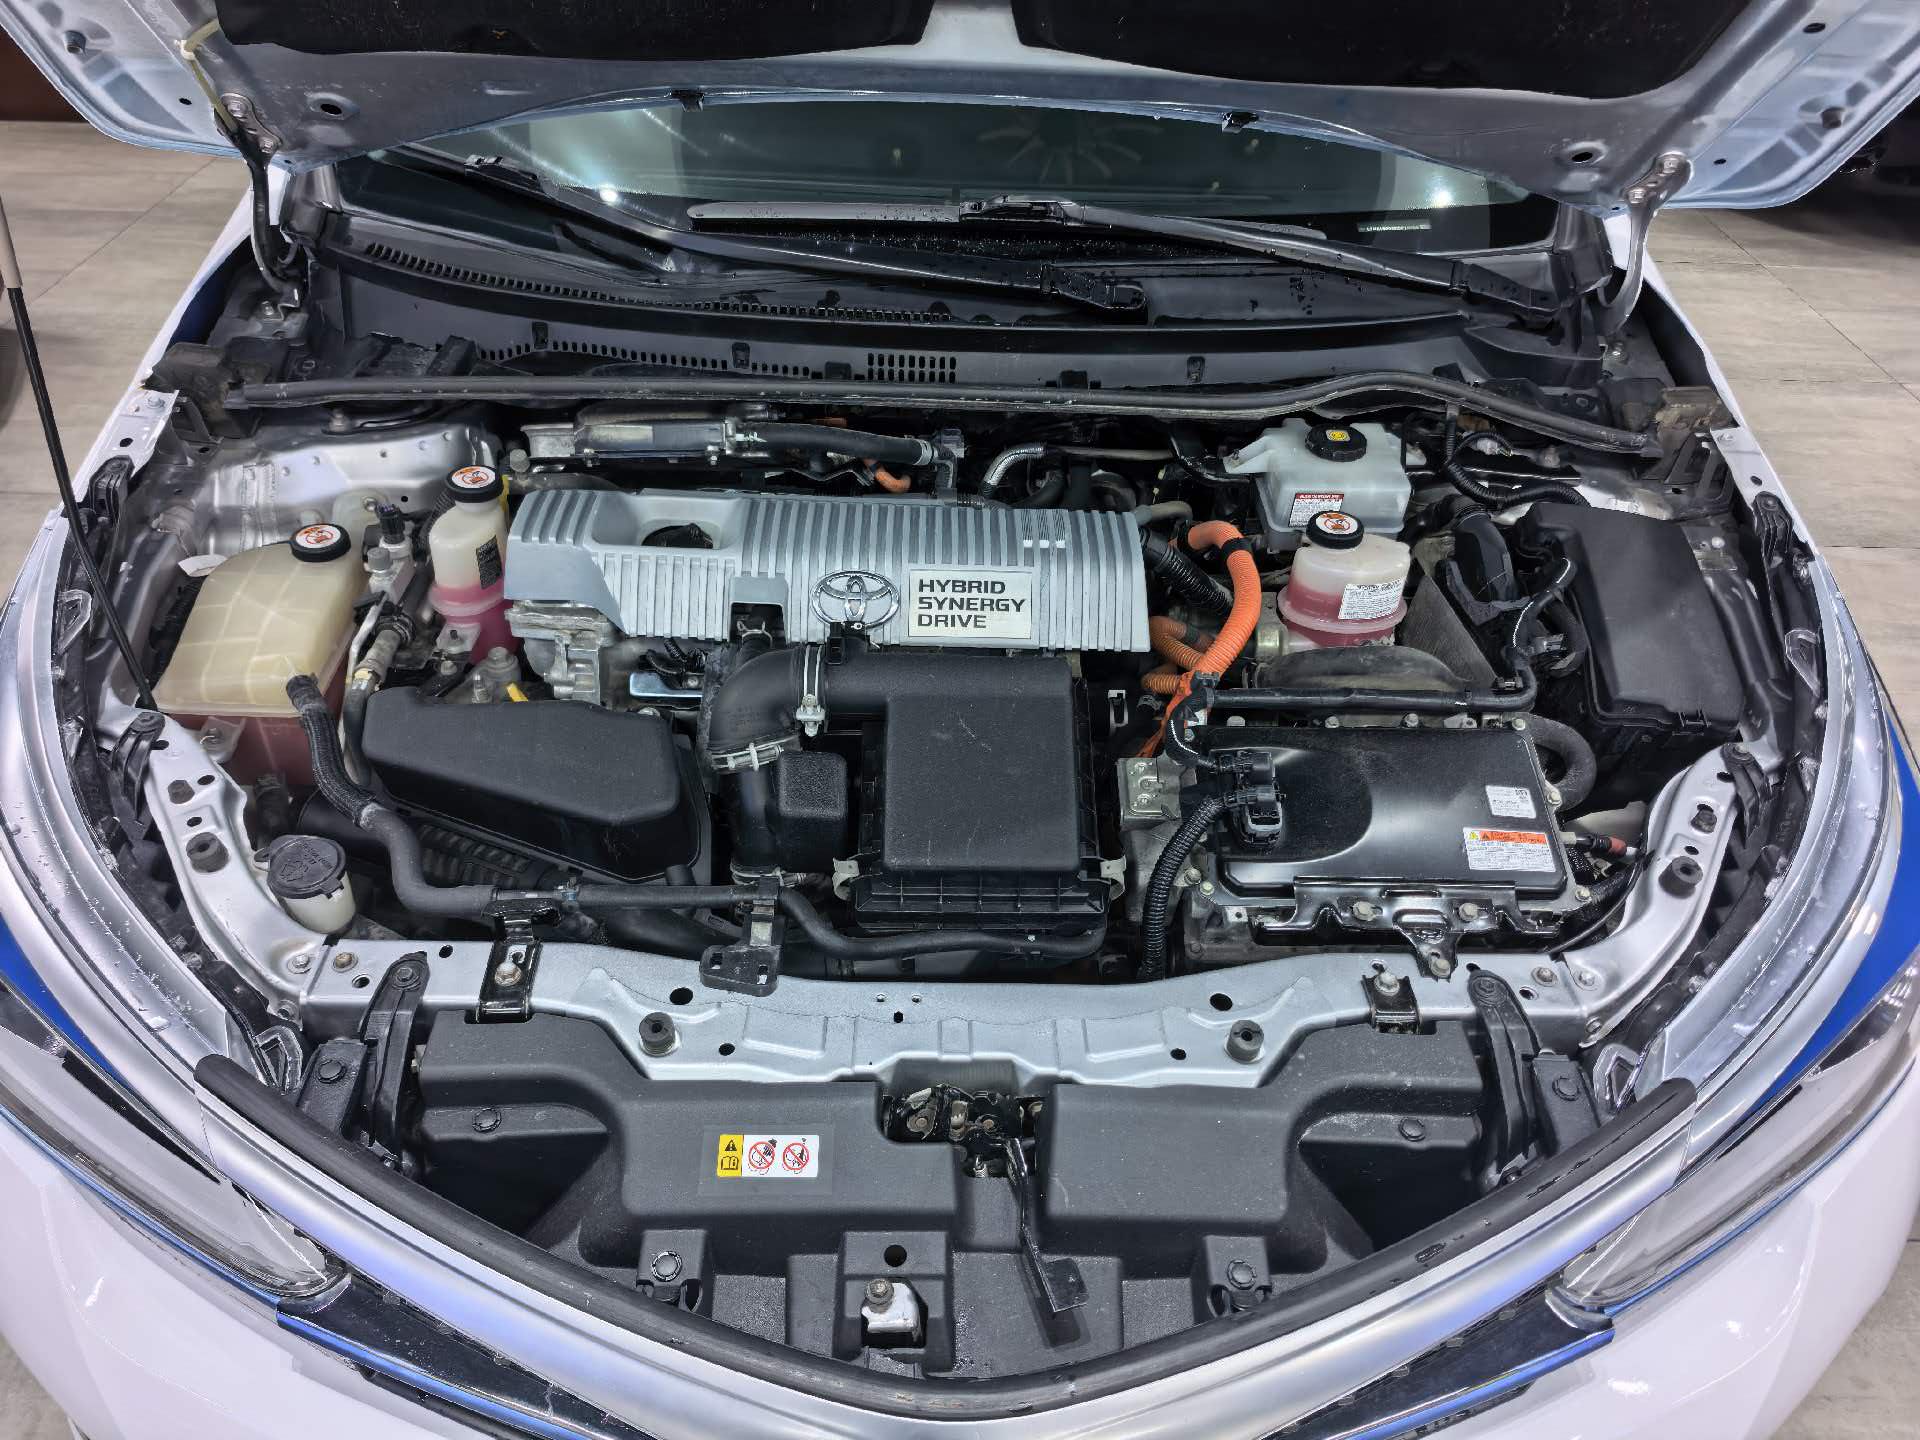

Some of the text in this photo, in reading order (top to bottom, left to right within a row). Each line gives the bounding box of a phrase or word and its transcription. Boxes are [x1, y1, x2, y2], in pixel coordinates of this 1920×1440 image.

[918, 579, 1006, 594] HYBRID
[918, 596, 1026, 613] SYNERGY
[917, 614, 987, 629] DRIVE
